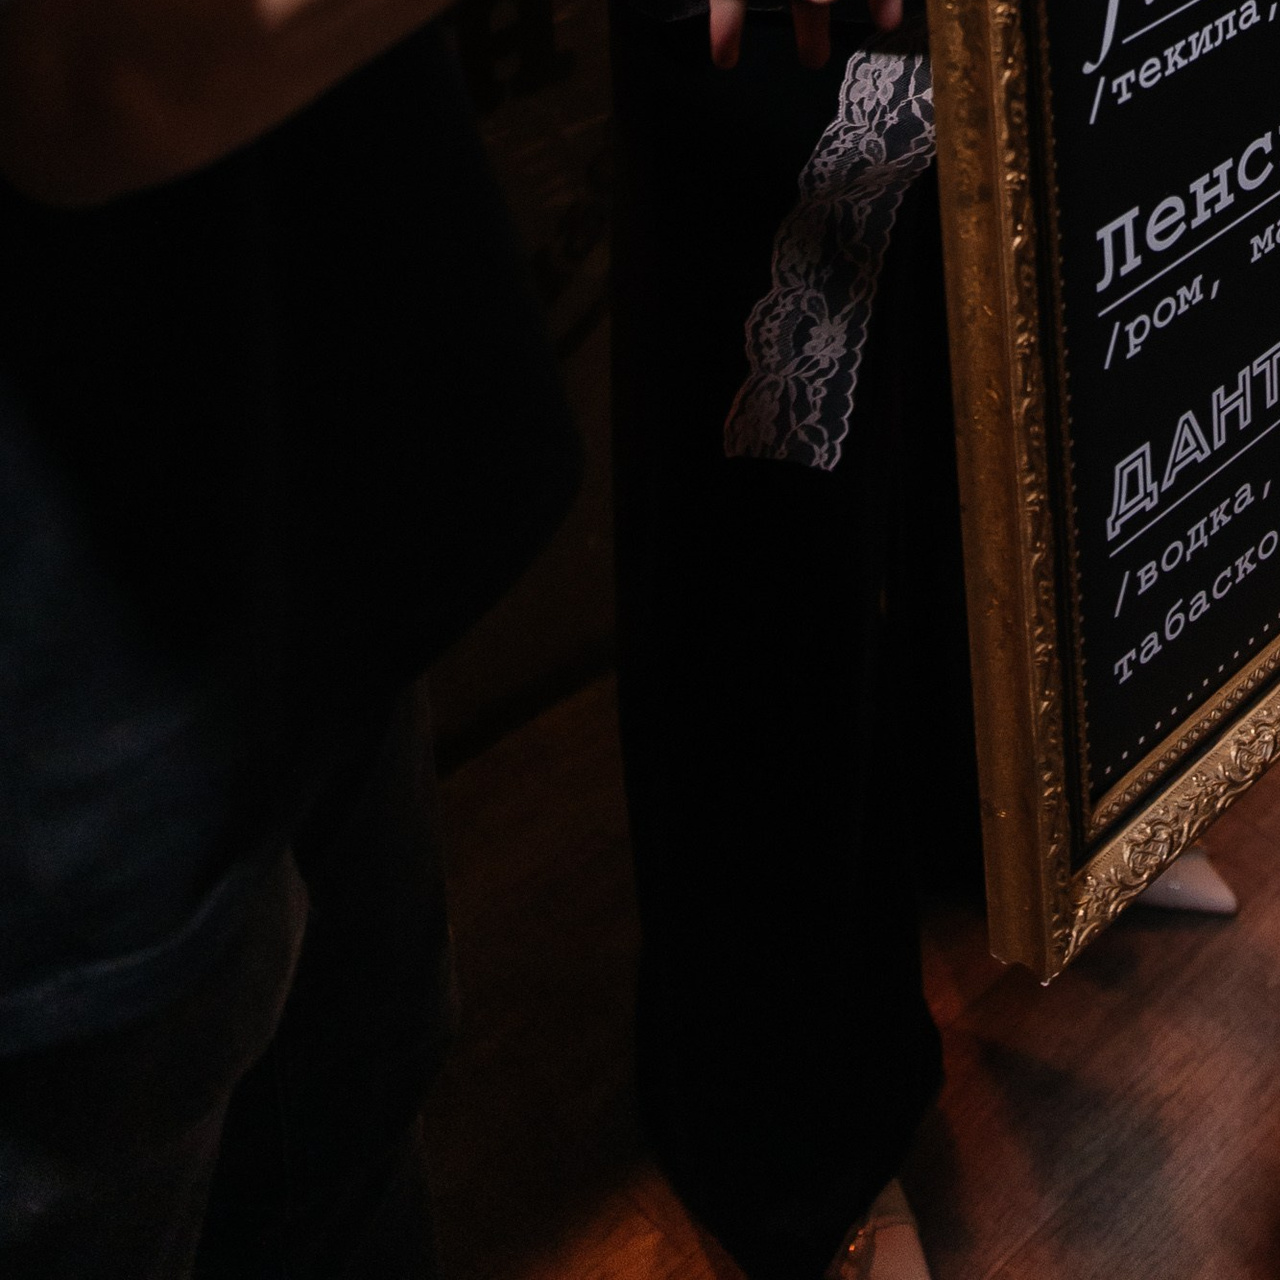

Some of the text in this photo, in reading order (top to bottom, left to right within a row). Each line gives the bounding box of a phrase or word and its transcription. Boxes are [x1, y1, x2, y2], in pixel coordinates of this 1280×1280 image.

[1089, 0, 1278, 124] /текила,
[1104, 273, 1221, 369] /ром,
[1114, 478, 1274, 617] /водка,
